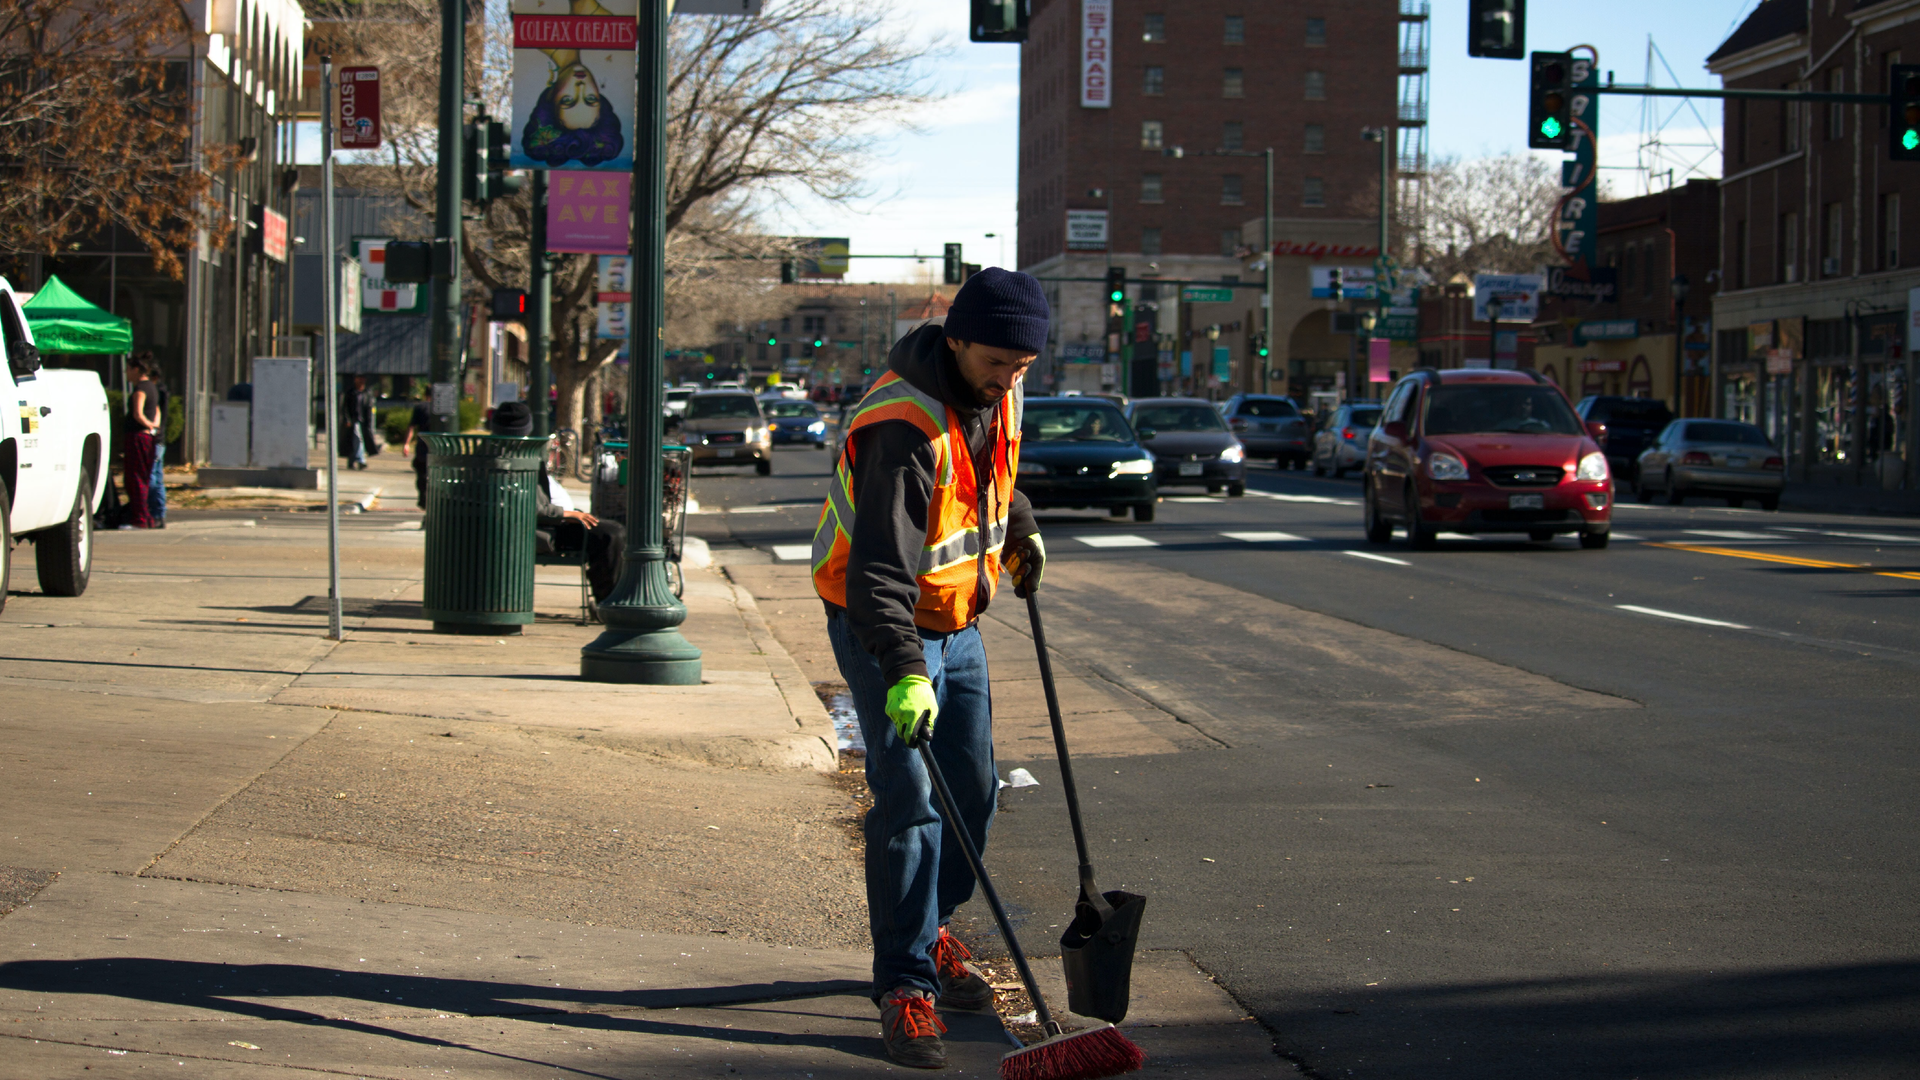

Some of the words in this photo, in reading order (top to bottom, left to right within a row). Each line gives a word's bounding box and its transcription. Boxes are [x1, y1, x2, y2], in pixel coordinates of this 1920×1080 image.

[520, 20, 572, 42] COLFAX
[575, 21, 634, 43] CREATES
[1086, 12, 1106, 101] STORAGE
[341, 71, 355, 83] MY
[342, 84, 355, 127] STOP
[1562, 60, 1590, 254] SATIRE
[559, 177, 620, 197] FAX
[557, 204, 619, 224] AVE
[1551, 268, 1615, 305] lounge
